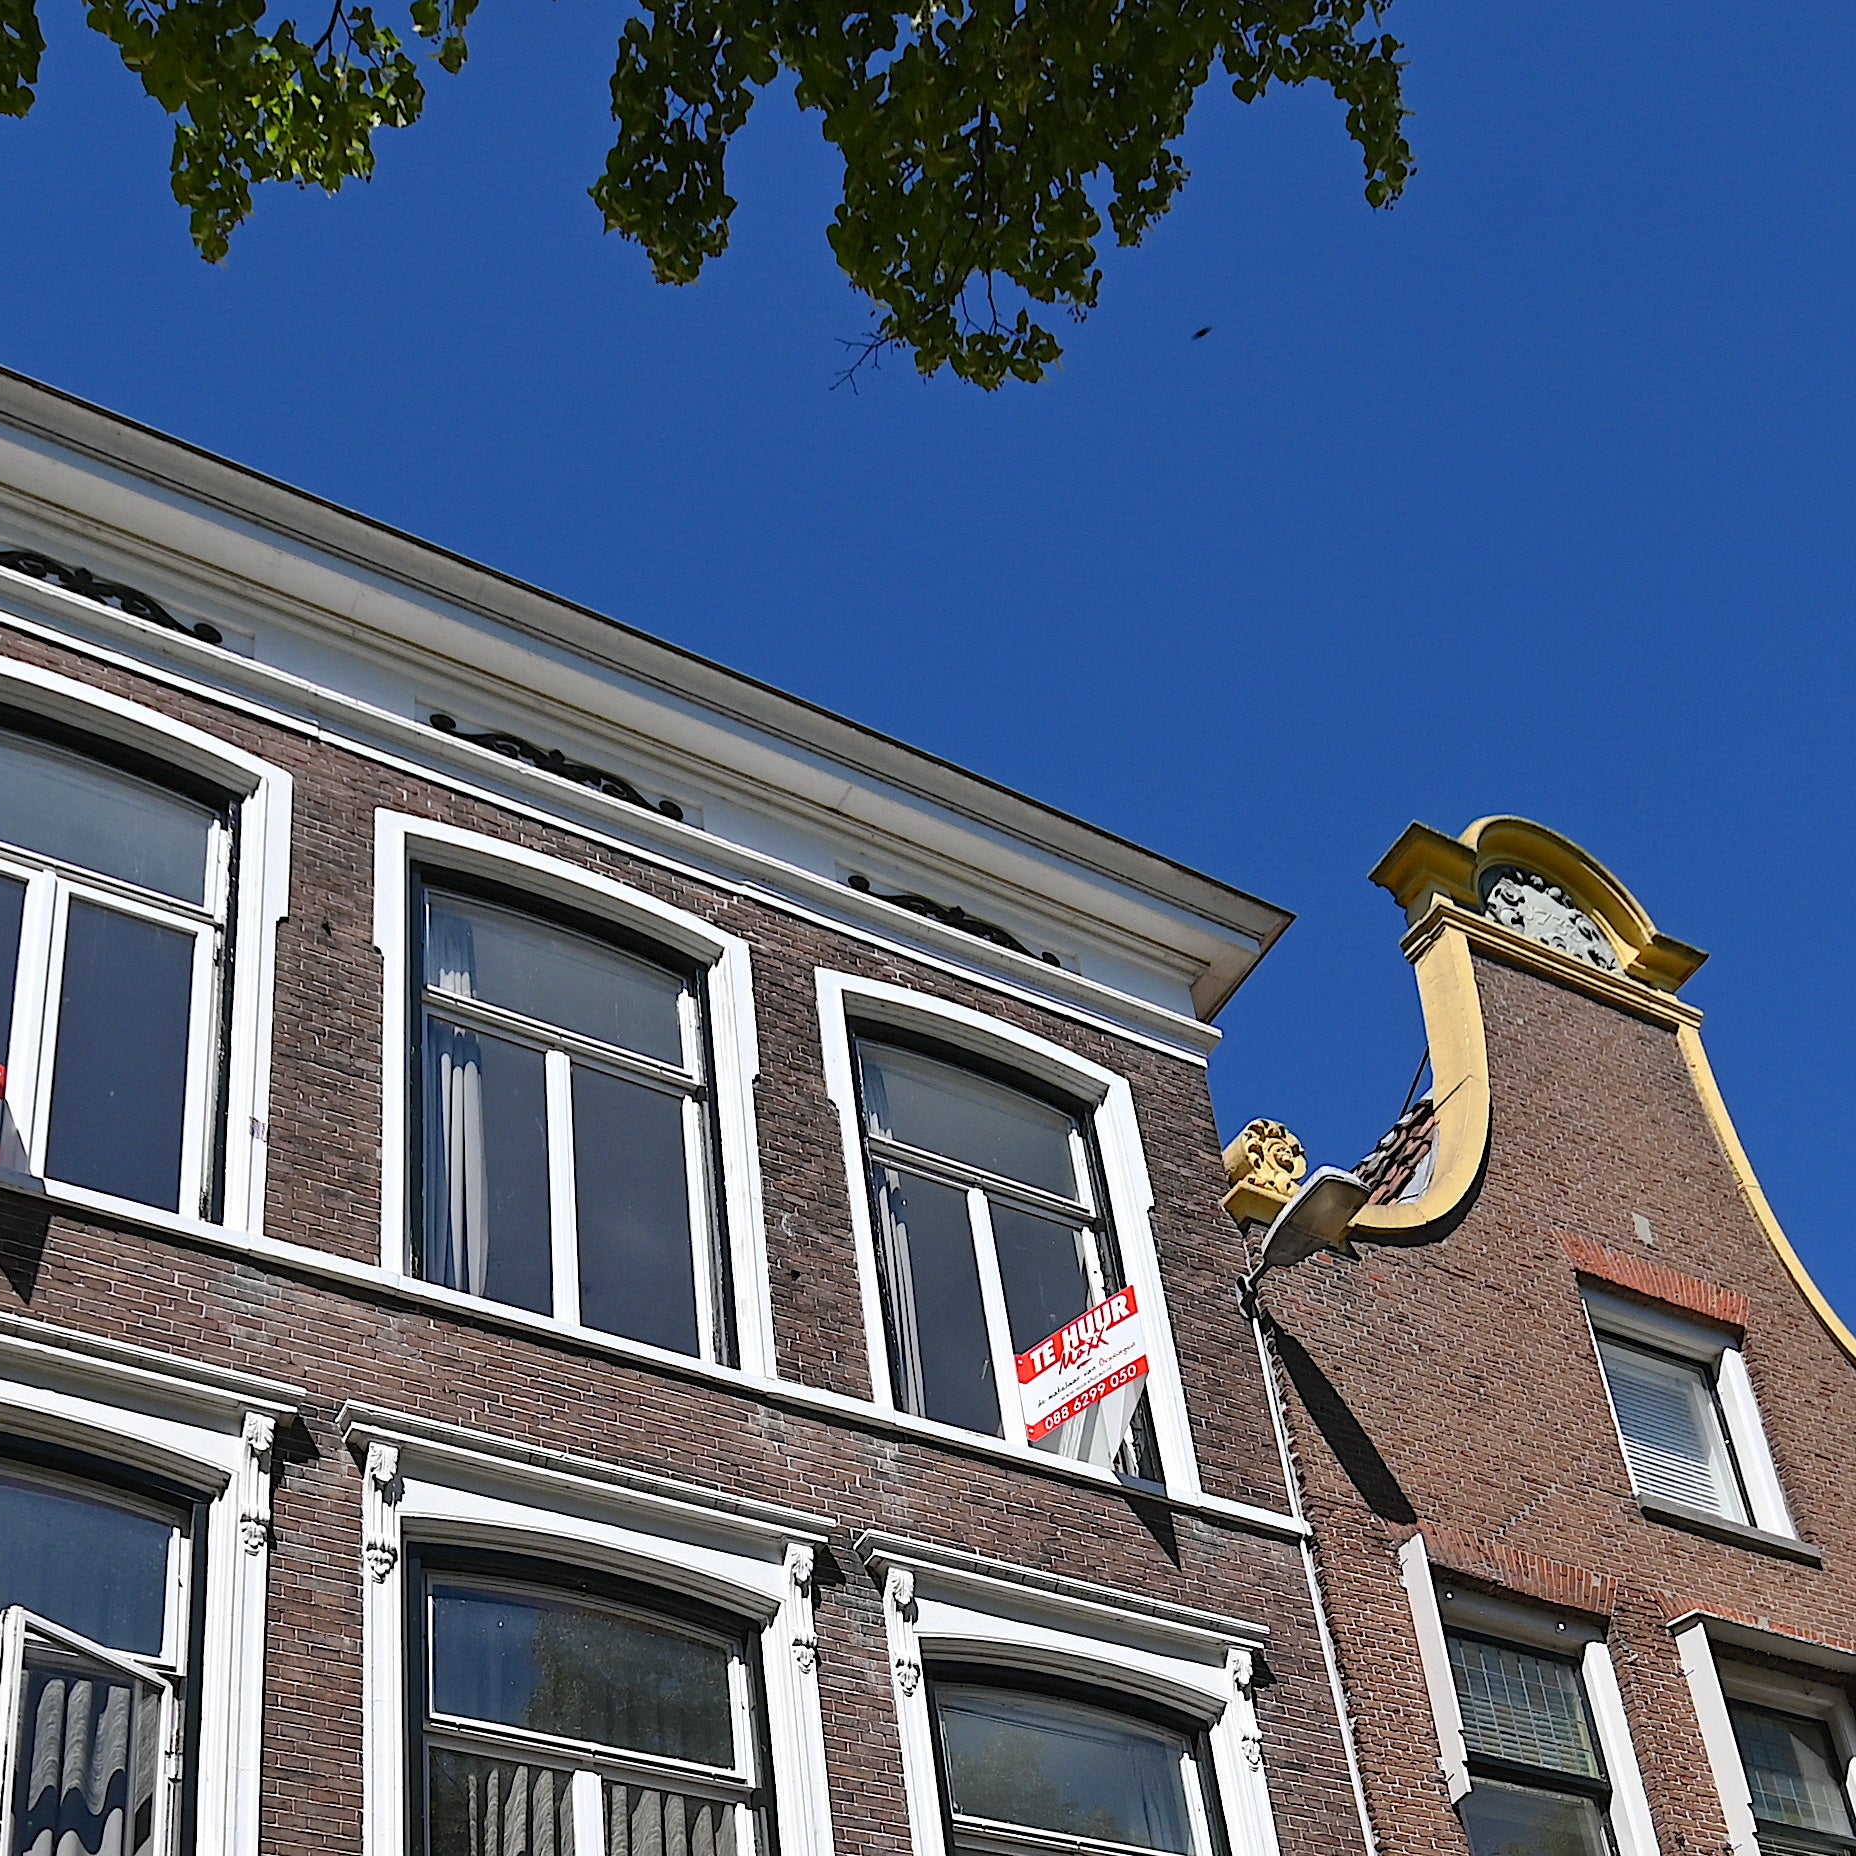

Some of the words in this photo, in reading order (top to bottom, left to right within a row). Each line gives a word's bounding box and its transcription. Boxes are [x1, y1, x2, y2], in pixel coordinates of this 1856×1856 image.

[1029, 1338, 1056, 1374] TE
[1061, 1294, 1131, 1353] HUUR
[1044, 1405, 1070, 1430] 088
[1073, 1382, 1106, 1412] 6299
[1109, 1364, 1137, 1389] 050
